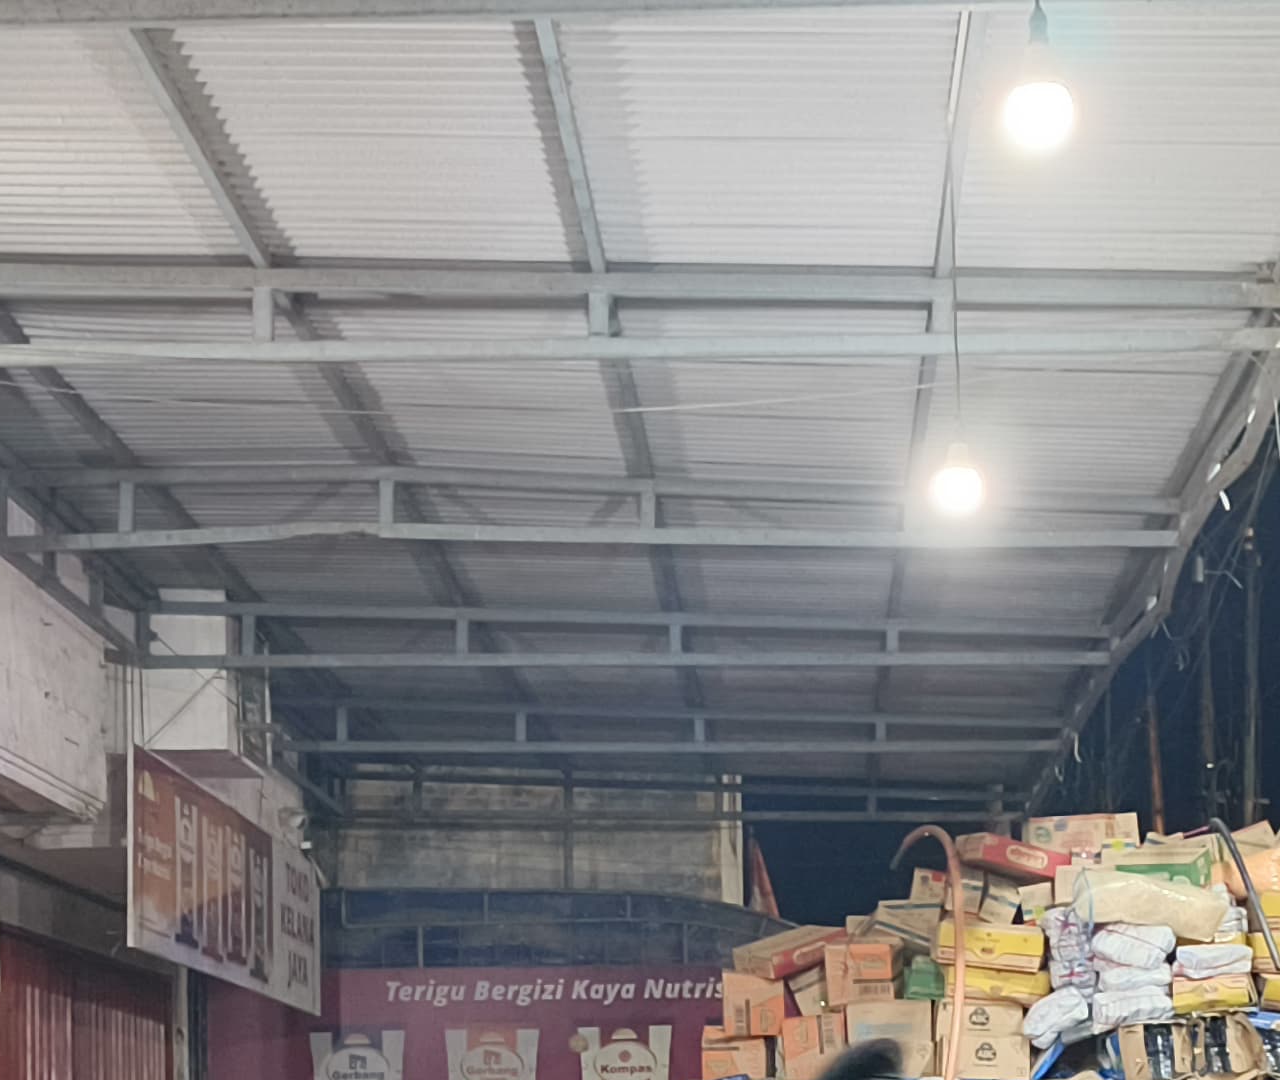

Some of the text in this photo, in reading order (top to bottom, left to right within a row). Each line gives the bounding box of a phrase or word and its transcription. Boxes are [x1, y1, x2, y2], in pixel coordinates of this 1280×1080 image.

[385, 977, 723, 1006] Terigu Bergizi Kaya Nutris
[600, 1063, 653, 1077] Kompas
